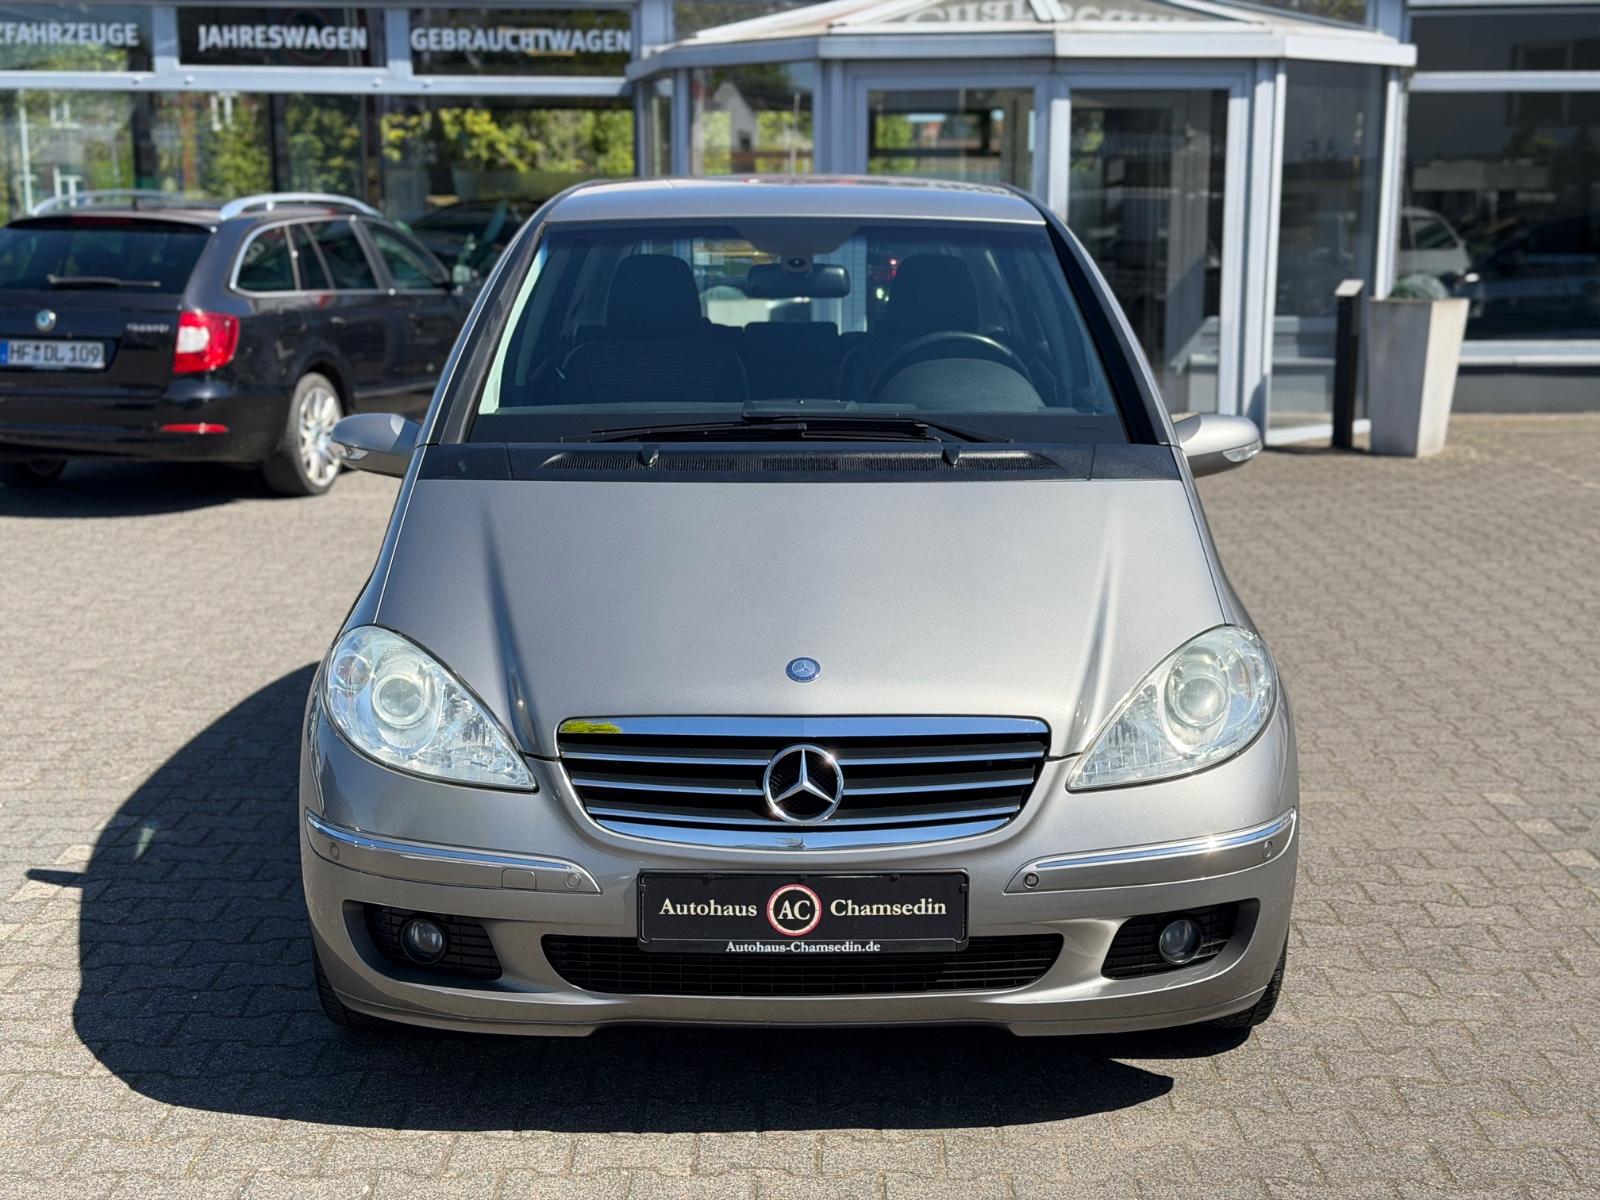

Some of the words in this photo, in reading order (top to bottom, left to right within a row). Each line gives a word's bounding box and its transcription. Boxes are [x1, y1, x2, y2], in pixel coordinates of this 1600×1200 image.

[198, 24, 367, 51] JAHRESWAGEN
[410, 27, 631, 53] GEBRAUCHTWAGEN
[10, 343, 31, 361] HF
[44, 343, 65, 362] DL
[69, 344, 100, 364] 109
[659, 897, 758, 917] Autohaus
[777, 899, 811, 921] AC
[830, 897, 948, 916] Chamsedin
[725, 940, 881, 954] Autohaus-Chamsedin.de
